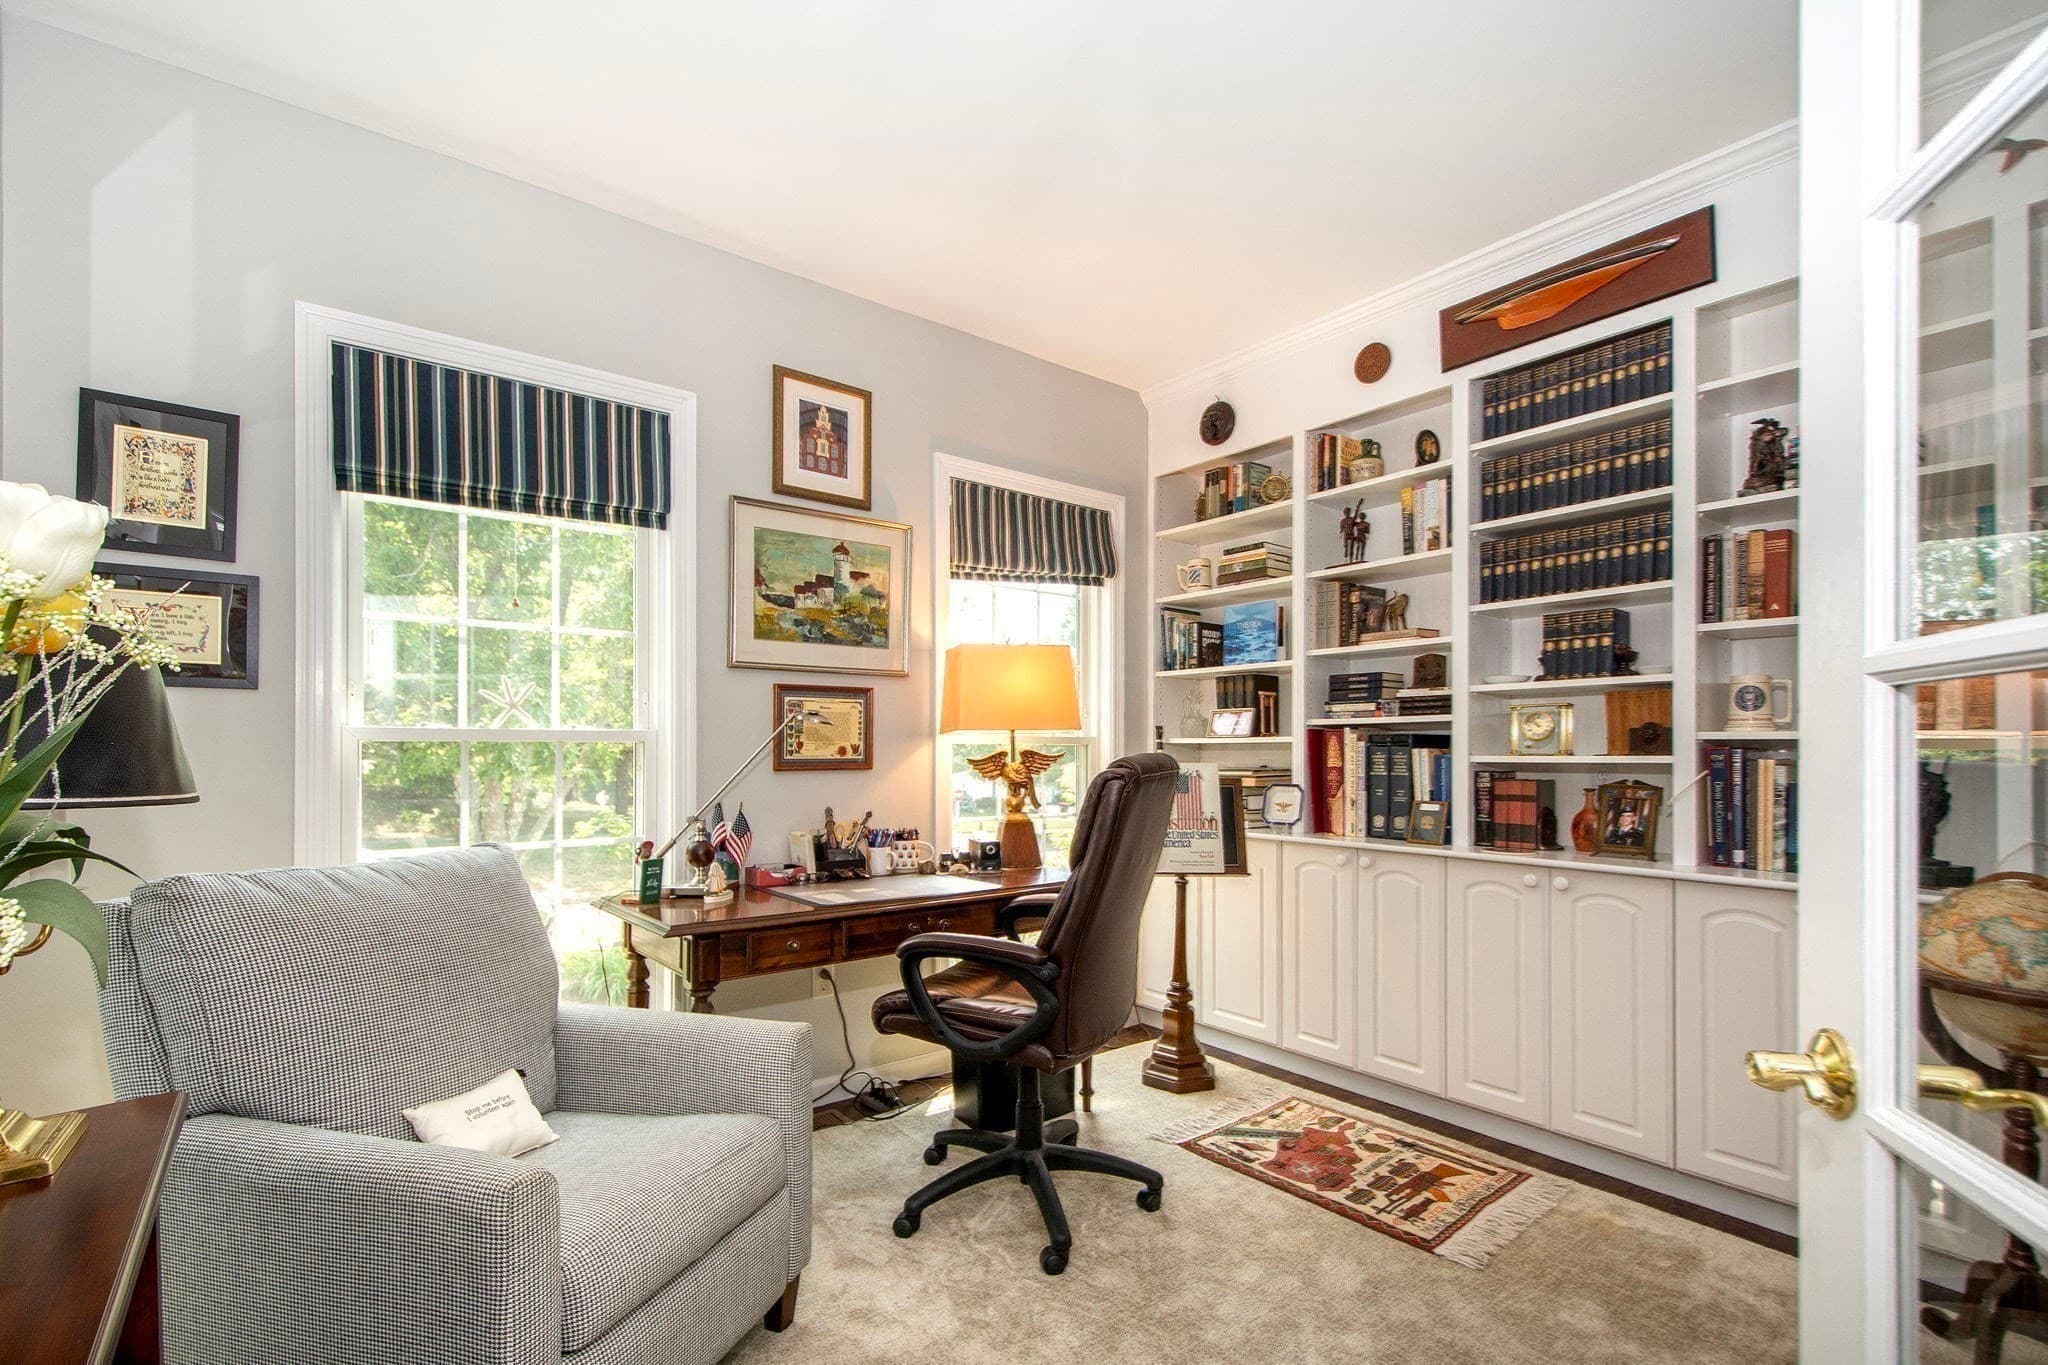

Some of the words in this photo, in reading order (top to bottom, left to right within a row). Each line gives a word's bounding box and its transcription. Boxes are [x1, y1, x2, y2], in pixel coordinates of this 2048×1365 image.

[1170, 831, 1195, 839] United
[1194, 831, 1218, 840] States
[1163, 839, 1191, 848] merica
[464, 1106, 481, 1116] Stop
[491, 1094, 511, 1104] before
